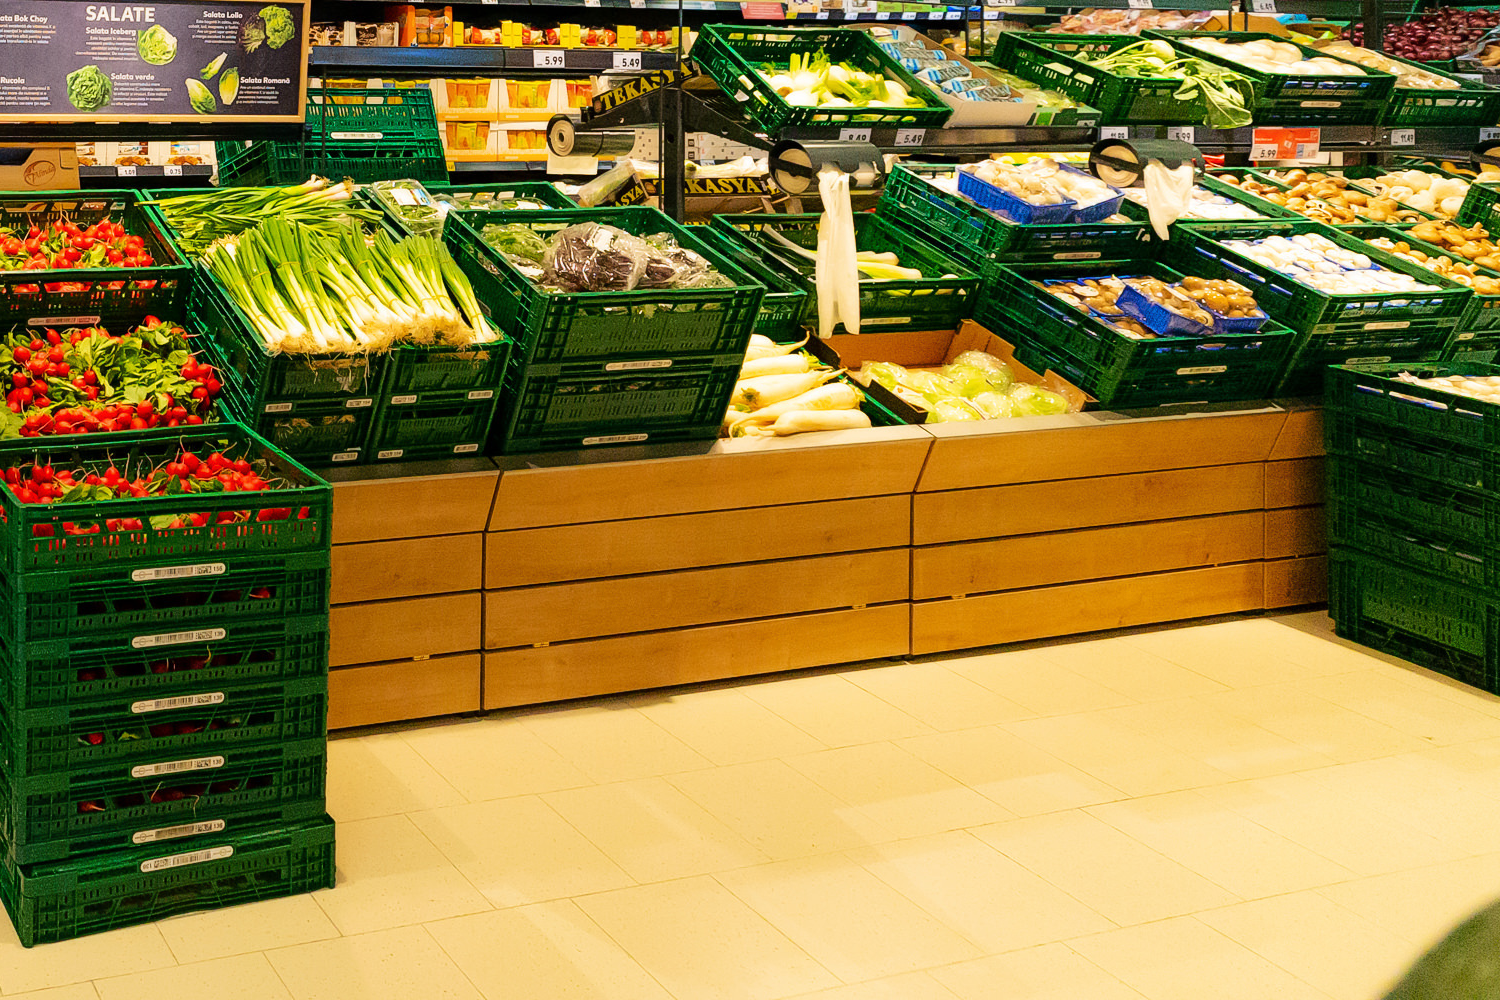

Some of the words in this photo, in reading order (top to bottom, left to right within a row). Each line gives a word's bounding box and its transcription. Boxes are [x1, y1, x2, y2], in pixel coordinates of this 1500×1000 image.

[85, 5, 156, 23] SALATE
[203, 11, 226, 19] Salata
[14, 14, 28, 22] Bok
[29, 15, 48, 24] Choy
[85, 26, 110, 35] Salata
[110, 27, 137, 37] Iceberg
[545, 56, 563, 65] 5.99
[622, 59, 640, 68] 5.49
[0, 76, 26, 85] Rucola
[110, 72, 134, 80] Salata
[134, 73, 155, 81] verde
[240, 76, 262, 84] Salata
[903, 134, 922, 144] 5.49
[1260, 149, 1276, 158] 5.99
[653, 177, 763, 194] TKASYA
